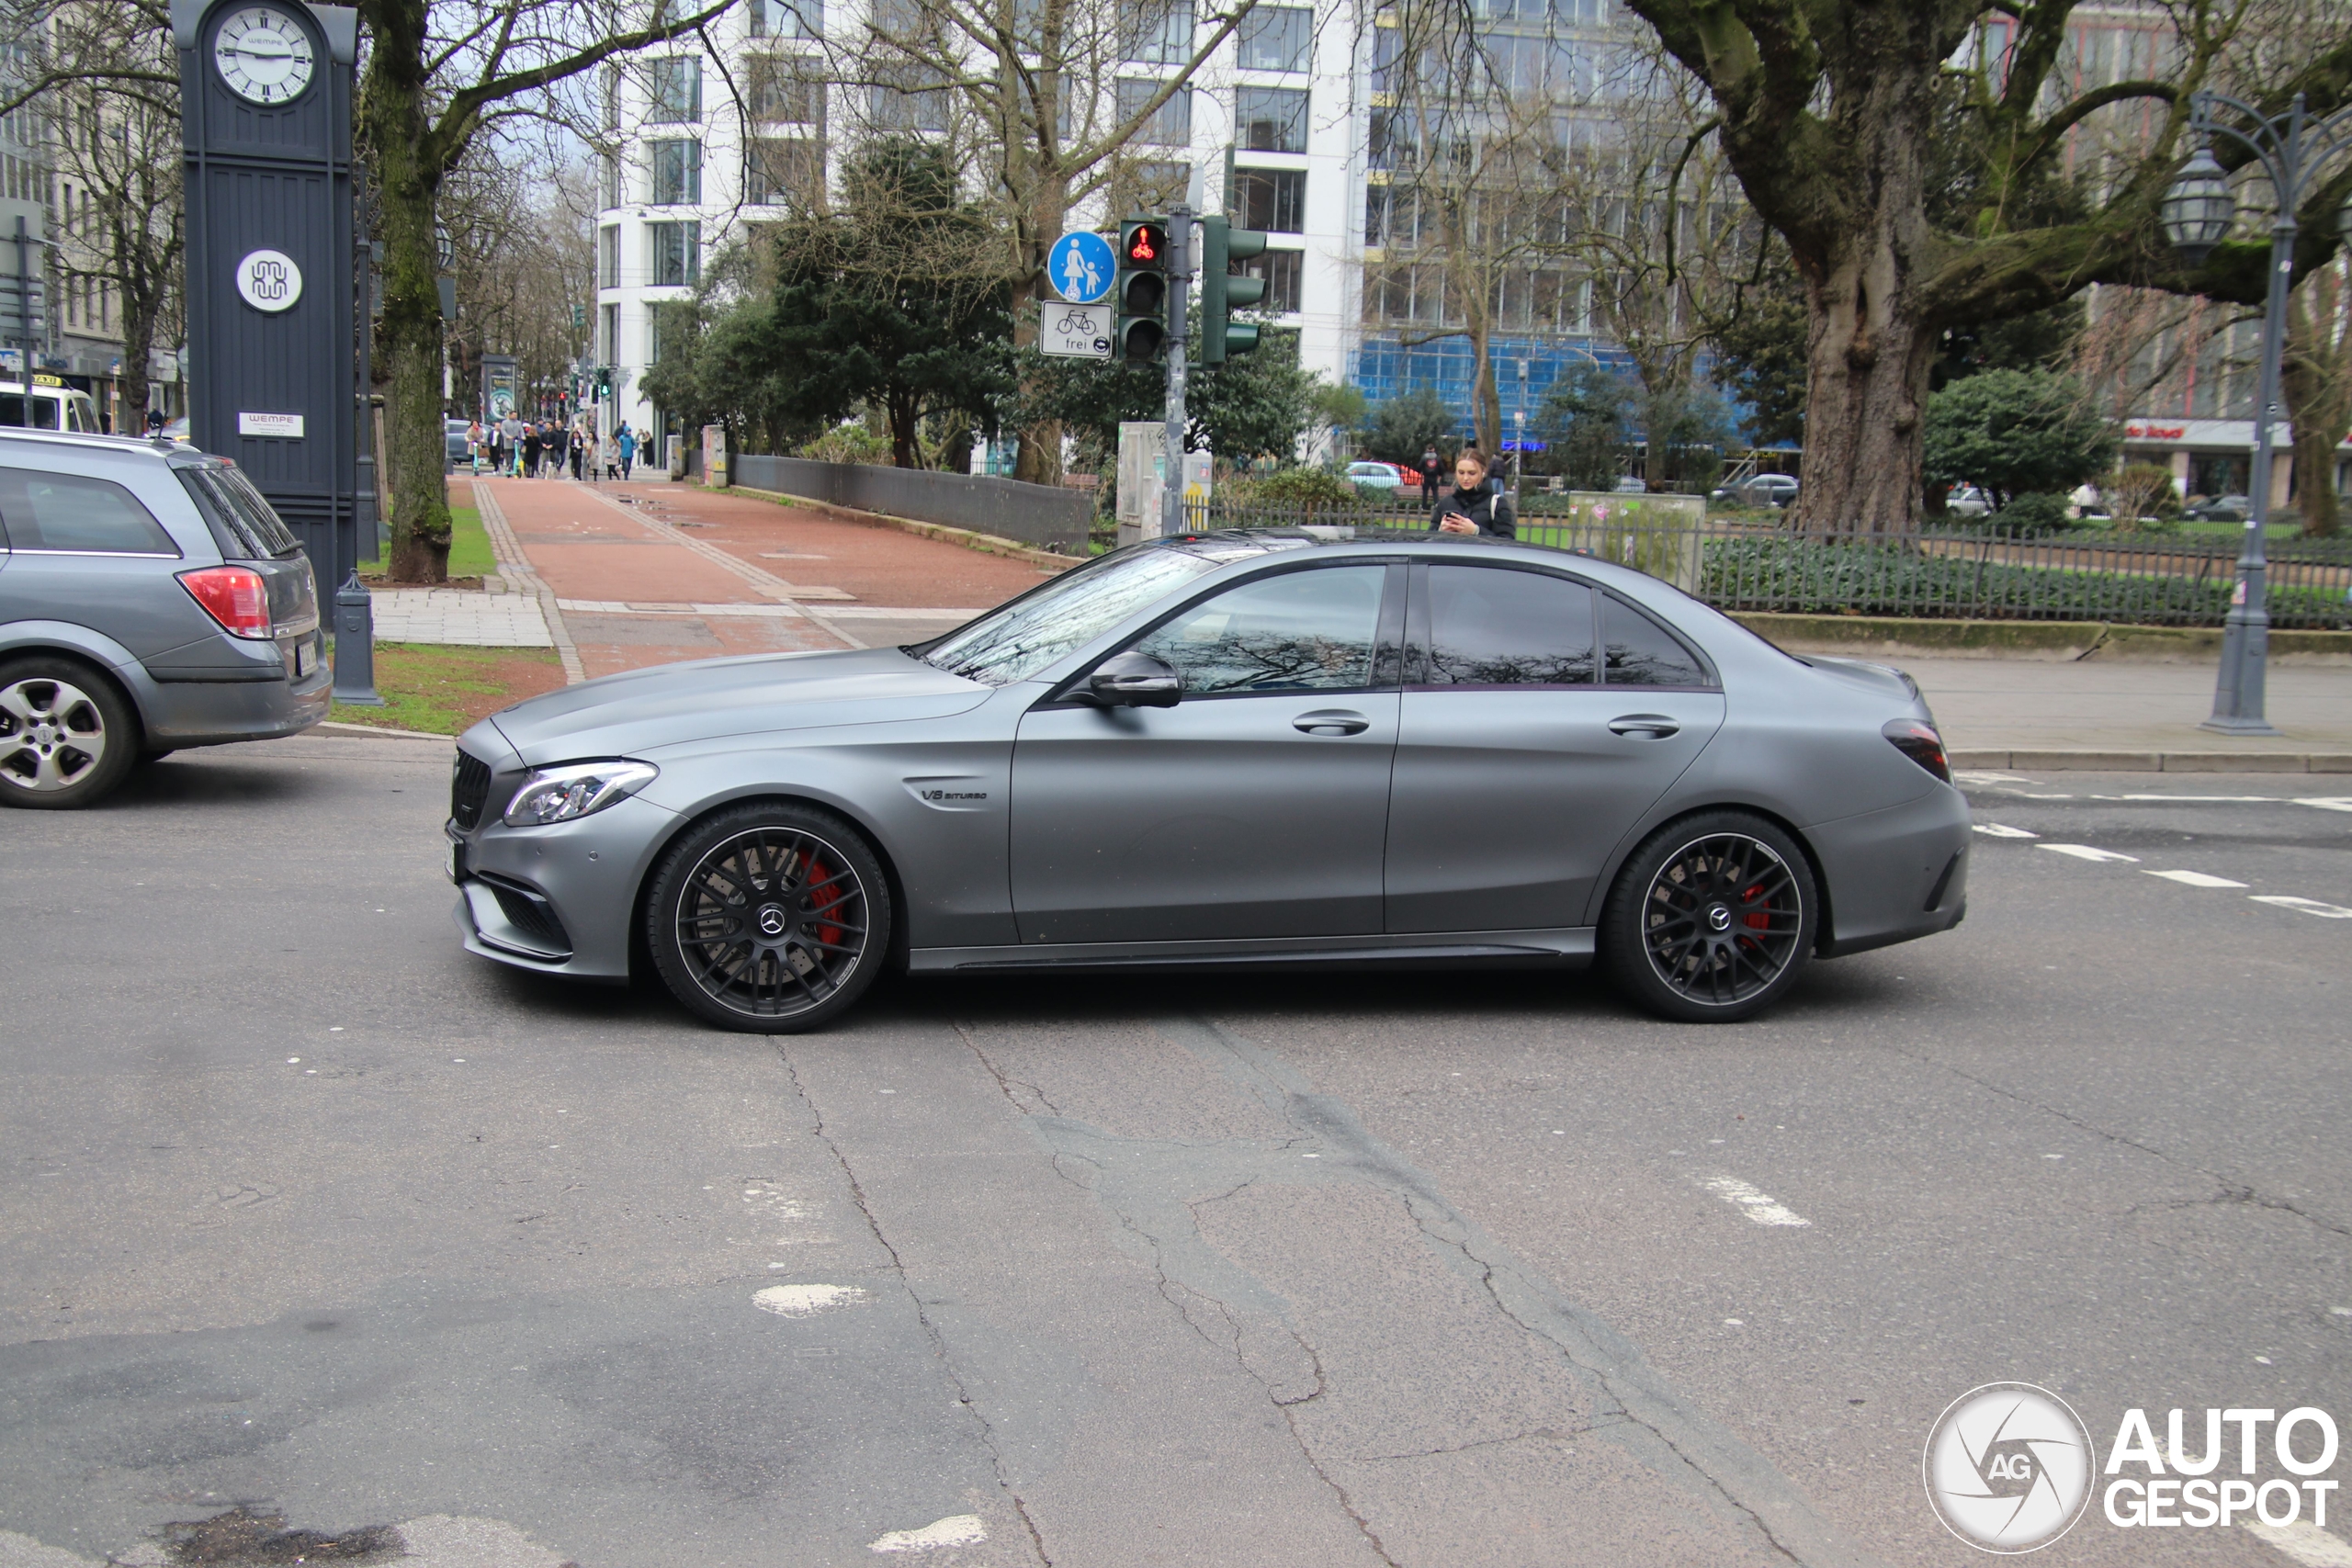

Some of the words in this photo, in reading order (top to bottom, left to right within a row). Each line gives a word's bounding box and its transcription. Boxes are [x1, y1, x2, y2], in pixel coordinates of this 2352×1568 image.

[247, 37, 283, 46] WEMPE
[1066, 337, 1087, 350] frei
[33, 375, 55, 384] TAXI
[248, 414, 294, 423] WEMPE
[922, 790, 943, 800] V8
